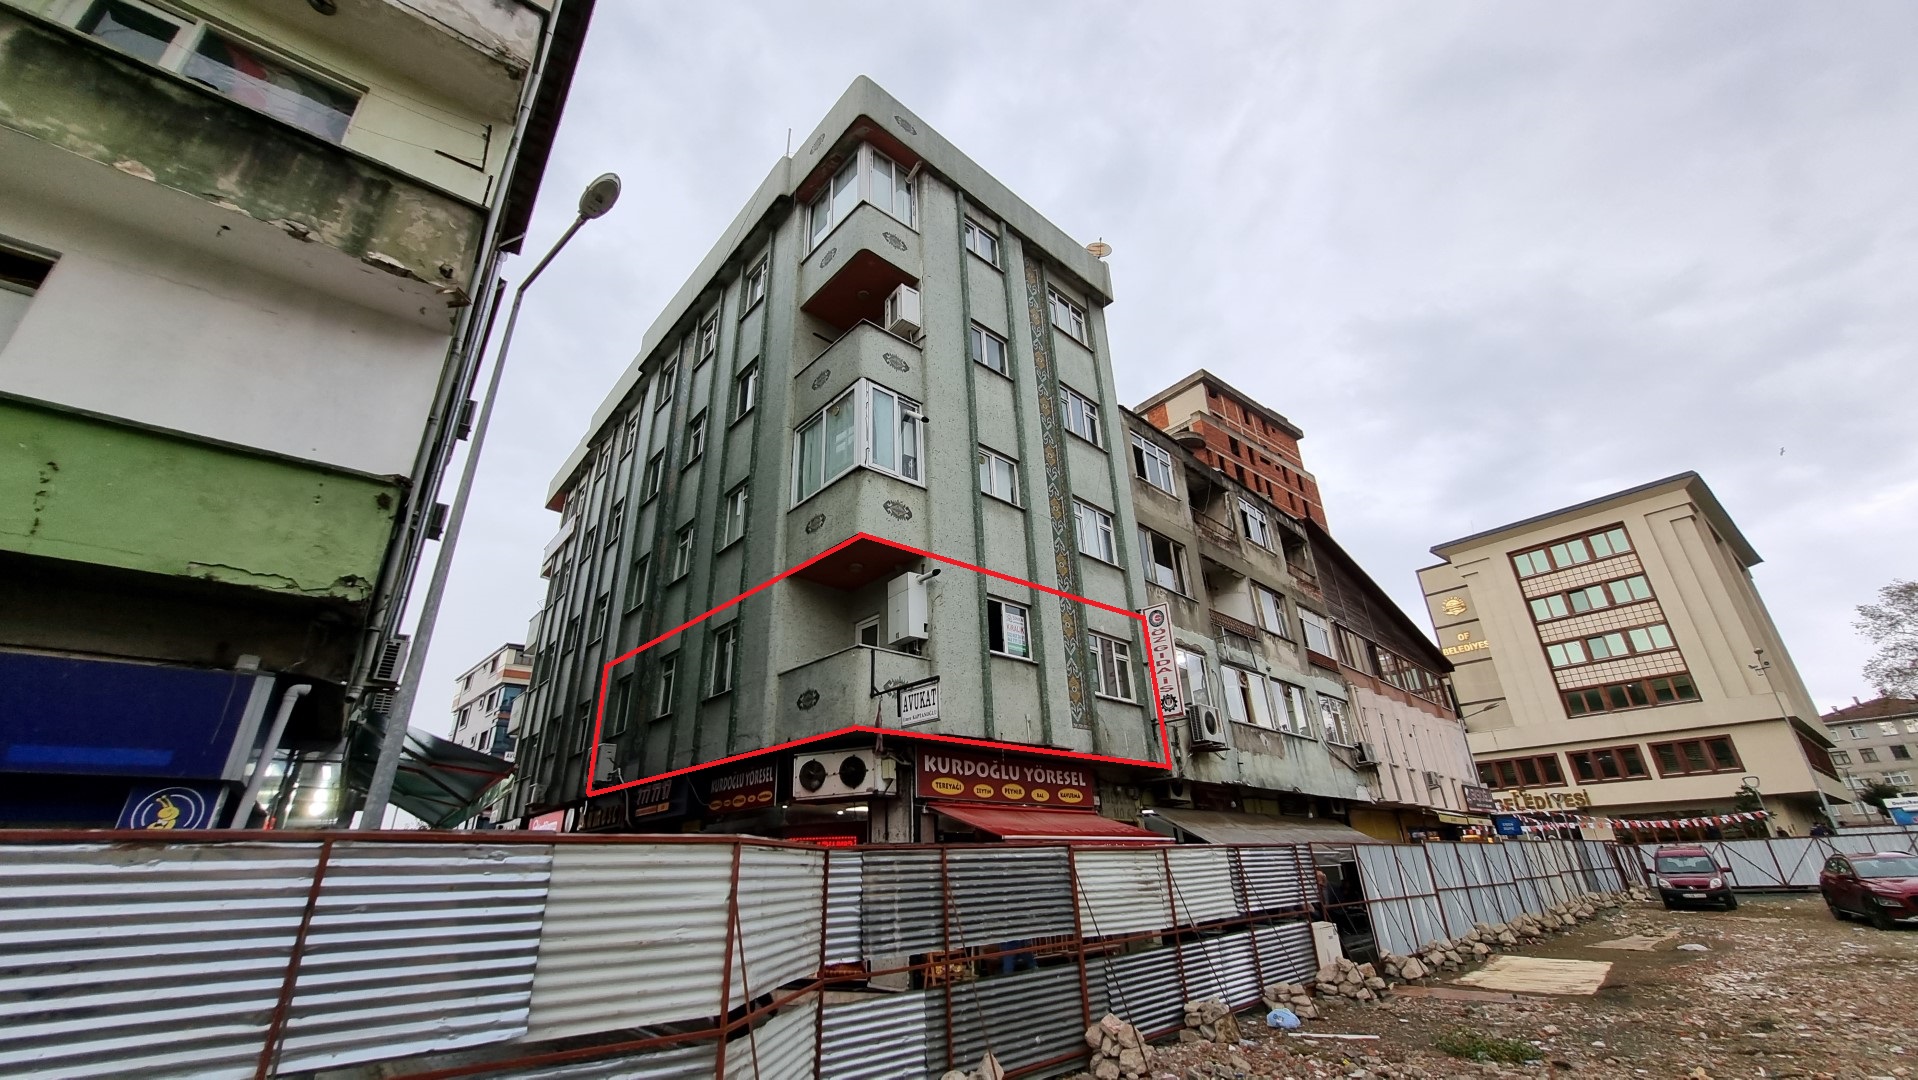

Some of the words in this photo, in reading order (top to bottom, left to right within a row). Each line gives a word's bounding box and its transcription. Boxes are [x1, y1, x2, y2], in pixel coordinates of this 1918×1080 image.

[1457, 632, 1470, 641] OF
[903, 688, 937, 713] AVUKAT
[924, 755, 1020, 780] KURDOĞLU
[1024, 764, 1087, 787] YÖRESEL
[935, 781, 962, 792] TEREYAĞI
